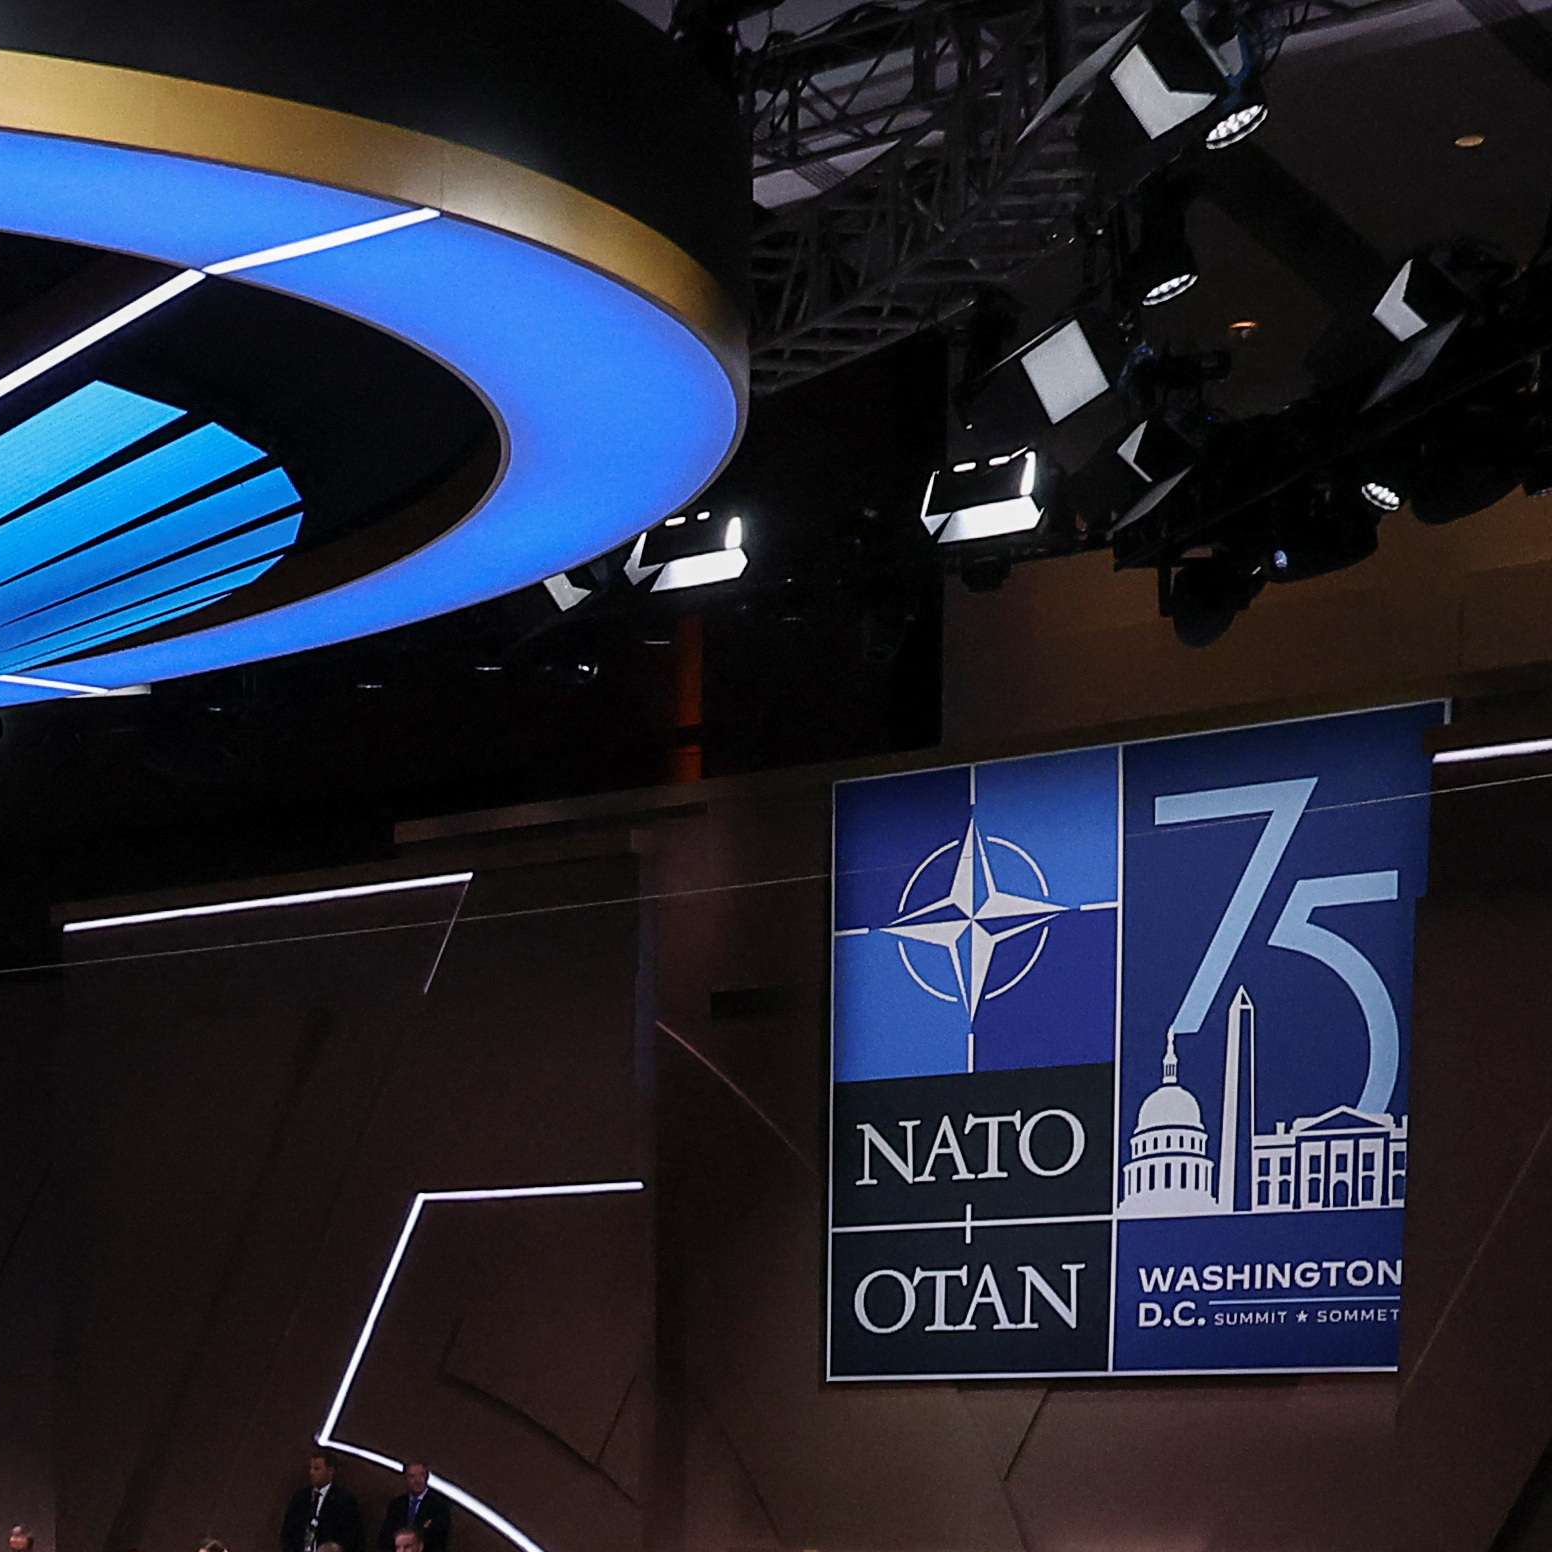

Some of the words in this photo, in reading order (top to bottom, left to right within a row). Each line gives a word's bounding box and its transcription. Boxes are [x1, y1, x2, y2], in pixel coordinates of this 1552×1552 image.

[1155, 776, 1400, 1115] 75
[856, 1109, 1086, 1186] NATO
[854, 1262, 1086, 1334] OTAN
[1139, 1259, 1403, 1293] WASHINGTON
[1139, 1301, 1207, 1328] D.C.
[1214, 1311, 1288, 1326] SUMMIT
[1316, 1308, 1400, 1324] SOMMET
